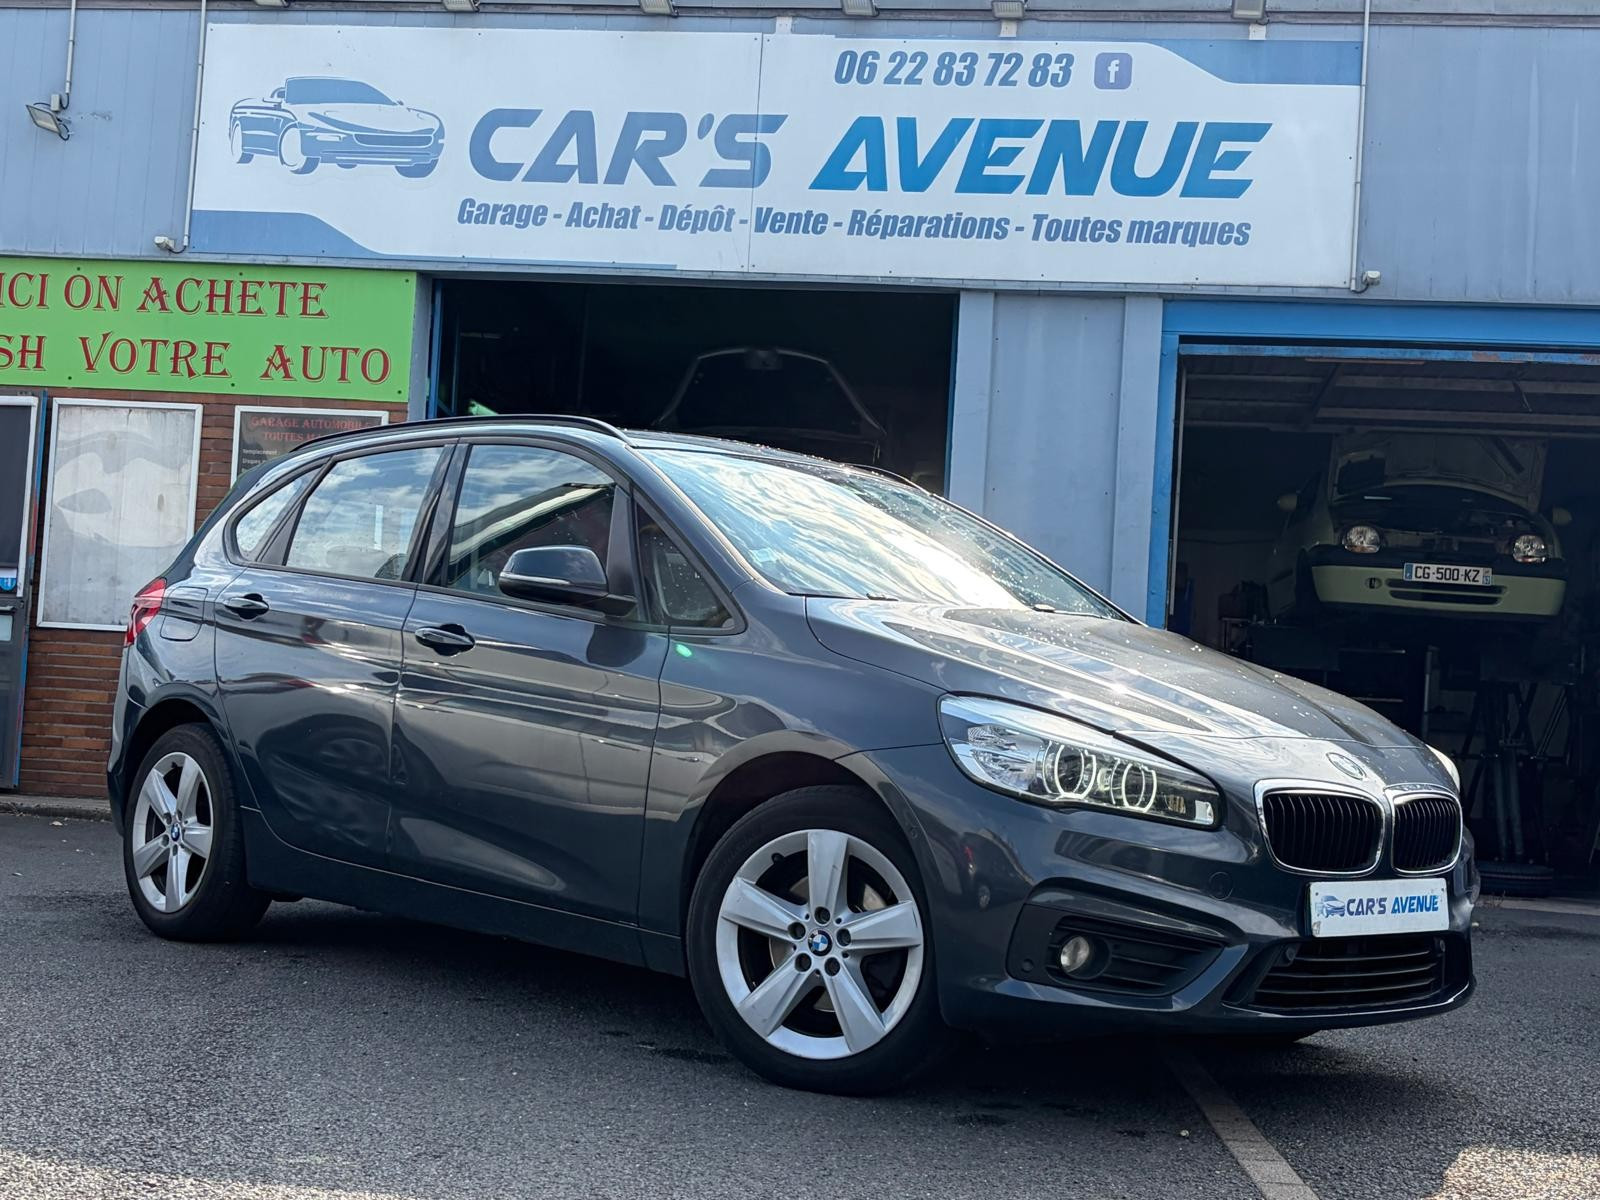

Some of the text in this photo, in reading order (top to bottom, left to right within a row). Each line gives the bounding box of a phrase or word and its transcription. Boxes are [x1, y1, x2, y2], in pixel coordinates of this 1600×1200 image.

[834, 50, 1075, 88] 06 22 83 72 83
[469, 108, 1273, 199] CAR'S AVENUE
[457, 197, 549, 230] Garage
[565, 201, 642, 230] Achat
[658, 204, 736, 235] Dépôt
[753, 206, 829, 236] Vente
[846, 209, 1011, 241] Réparations
[1032, 213, 1123, 244] Toutes
[1126, 219, 1252, 248] marques
[64, 274, 124, 311] ON
[137, 276, 329, 318] ACHETE
[79, 331, 232, 379] VOTRE
[260, 344, 392, 384] AUTO
[1346, 894, 1439, 917] CAR'S AVENUE
